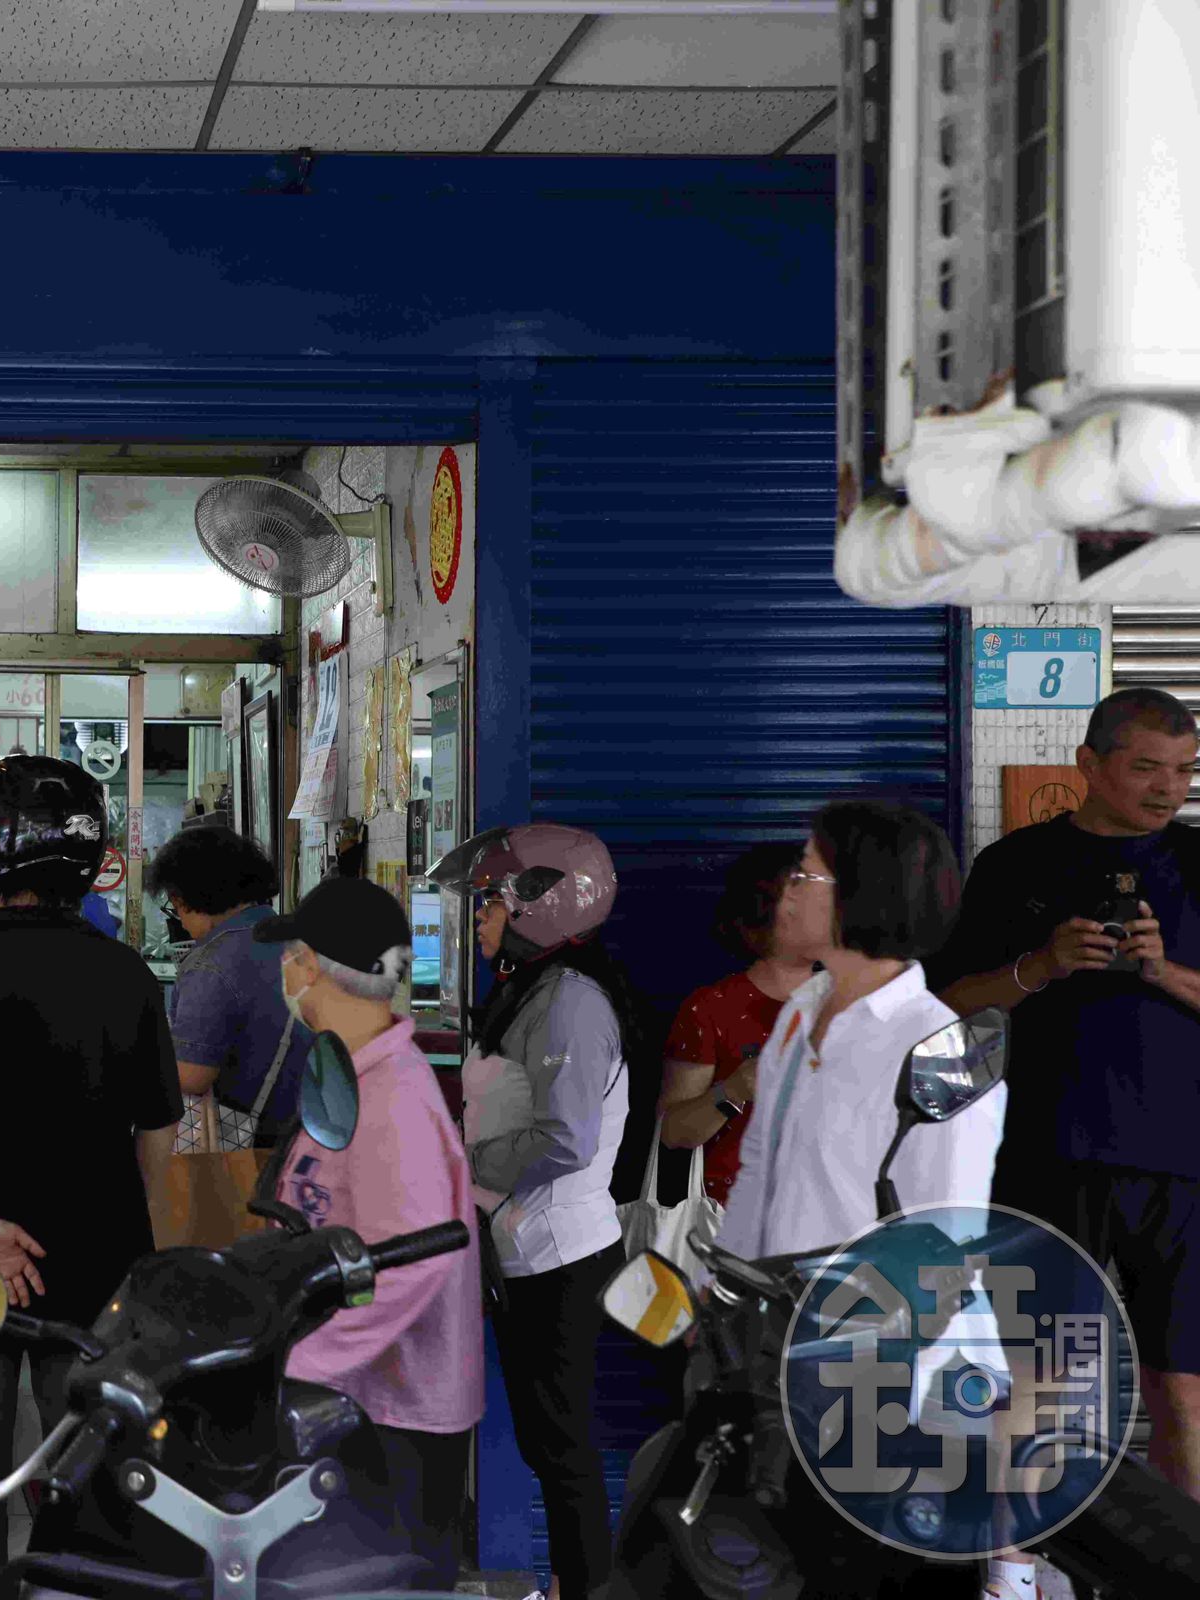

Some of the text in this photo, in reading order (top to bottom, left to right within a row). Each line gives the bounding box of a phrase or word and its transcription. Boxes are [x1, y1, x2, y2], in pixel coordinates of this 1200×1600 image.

[1011, 632, 1093, 648] 北門街
[1039, 657, 1065, 699] 8
